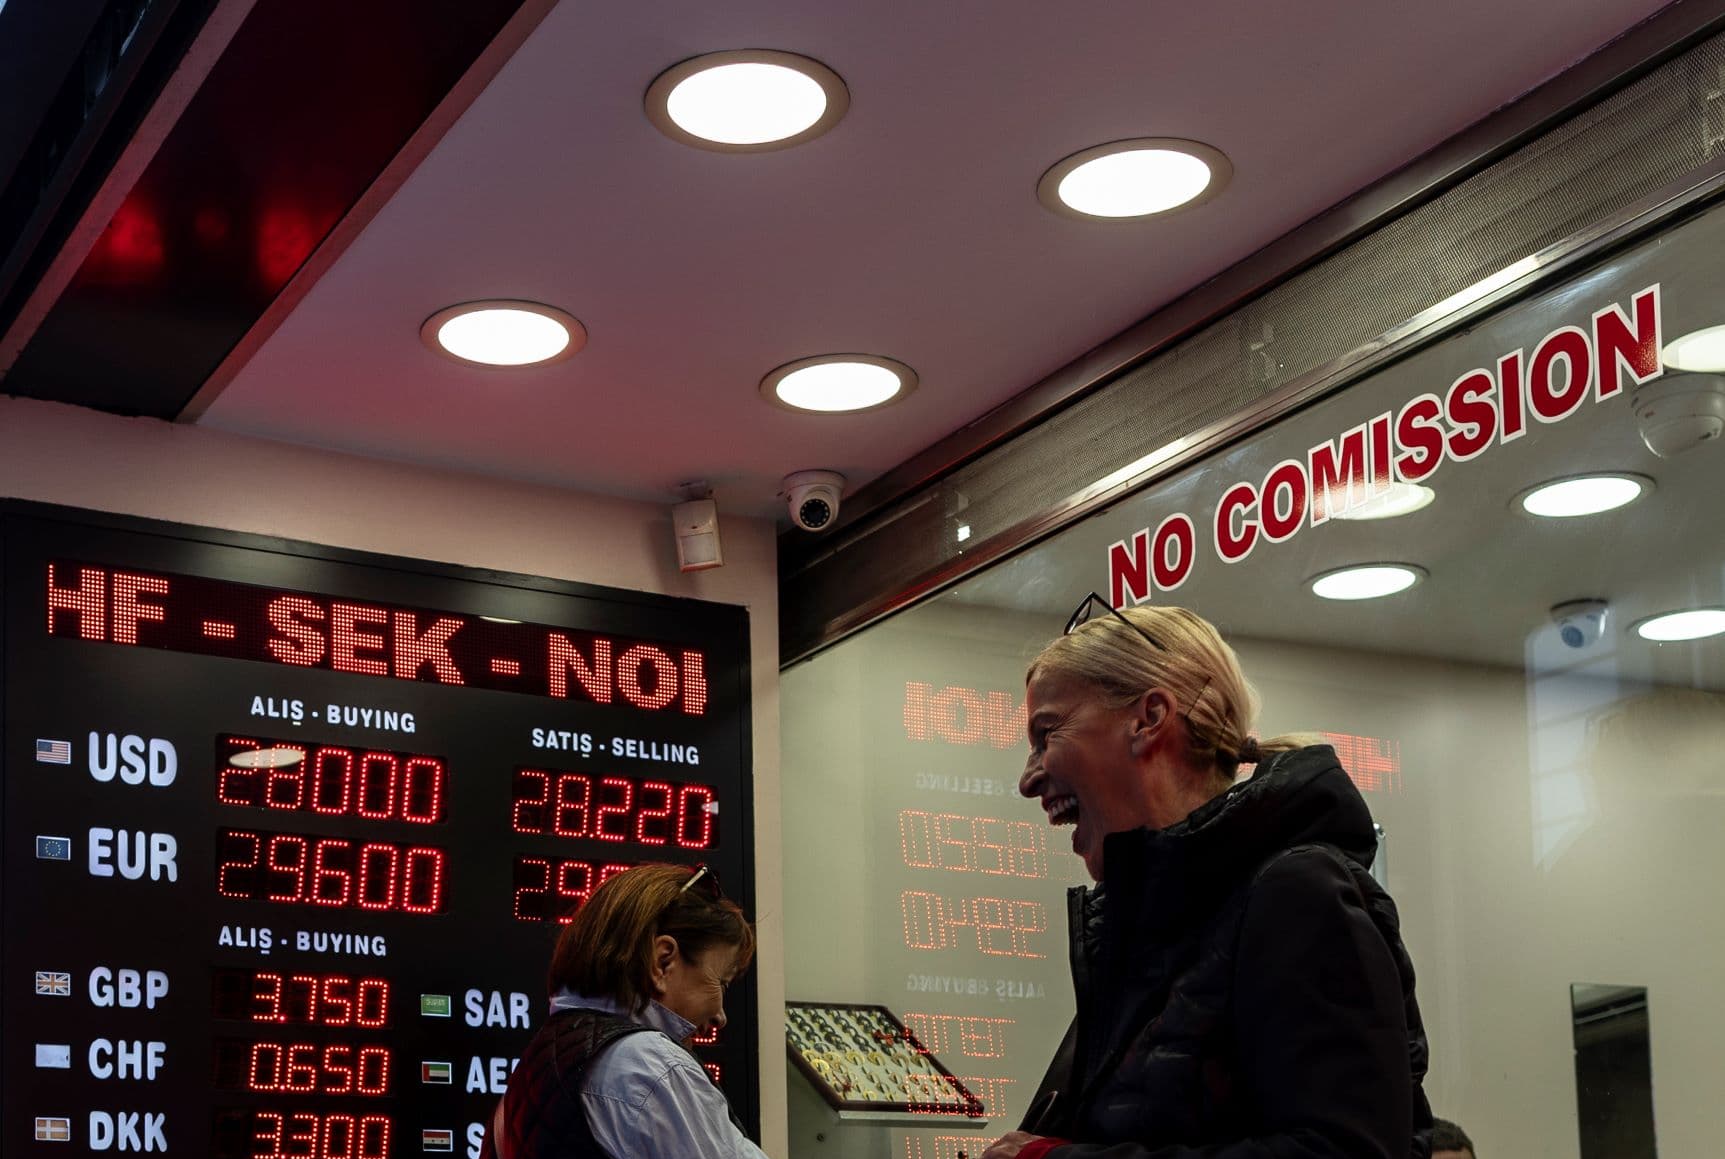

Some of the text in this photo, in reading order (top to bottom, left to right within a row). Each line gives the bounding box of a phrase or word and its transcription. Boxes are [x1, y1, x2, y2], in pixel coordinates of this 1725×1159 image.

[1108, 284, 1663, 610] NO COMISSION
[268, 596, 465, 685] SEK
[326, 704, 416, 734] BUYING
[88, 731, 178, 787] USD
[611, 737, 700, 765] SELLING
[88, 827, 178, 883] EUR
[296, 931, 387, 957] BUYING
[88, 966, 169, 1010] GBP
[253, 973, 388, 1027] 3.750
[464, 989, 530, 1029] SAR
[88, 1038, 166, 1081] CHF
[249, 1043, 389, 1094] 0.650
[466, 1056, 521, 1094] AE
[89, 1110, 168, 1153] DKK
